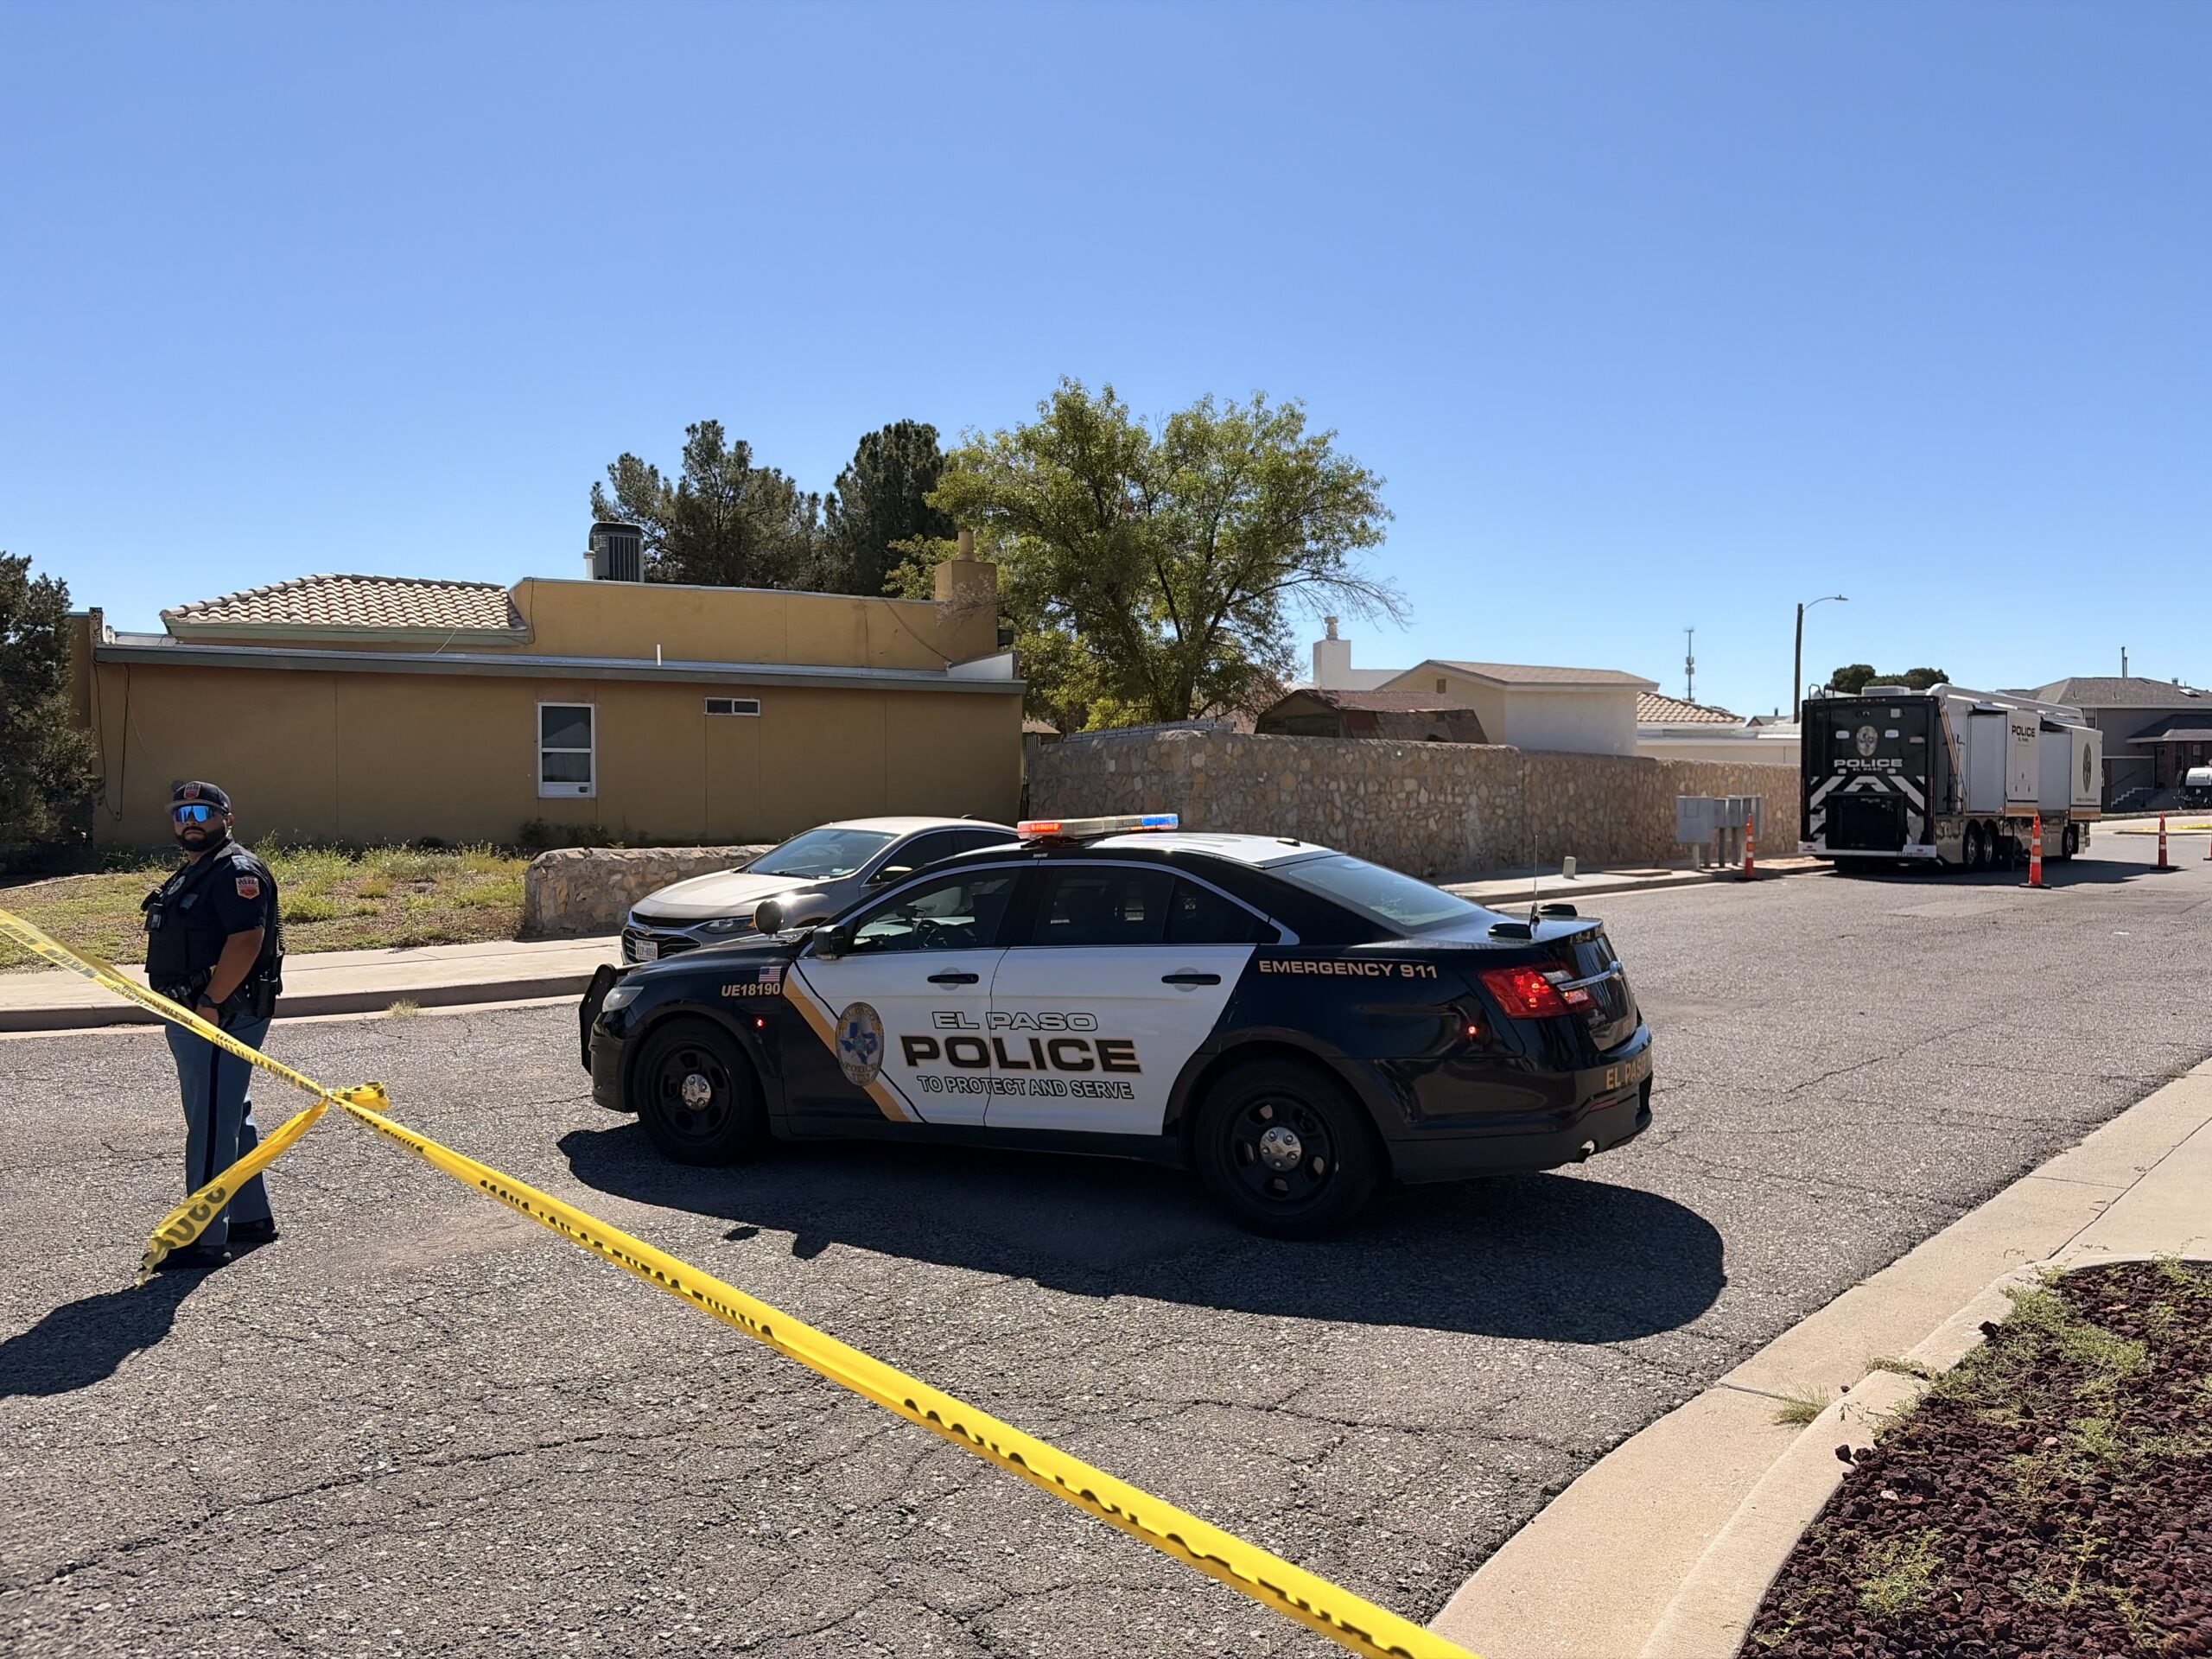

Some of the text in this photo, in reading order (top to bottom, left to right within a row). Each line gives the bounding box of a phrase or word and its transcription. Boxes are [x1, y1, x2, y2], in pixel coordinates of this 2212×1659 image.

[2012, 725, 2036, 737] POLICE
[1834, 759, 1903, 767] POLICE
[1259, 961, 1437, 978] EMERGENCY 911
[721, 983, 780, 996] UE18190
[932, 1012, 1098, 1032] EL PASO
[900, 1035, 1143, 1075] POLICE
[917, 1076, 1135, 1099] TO PROTECT AND SERVE
[1606, 1067, 1621, 1090] EL
